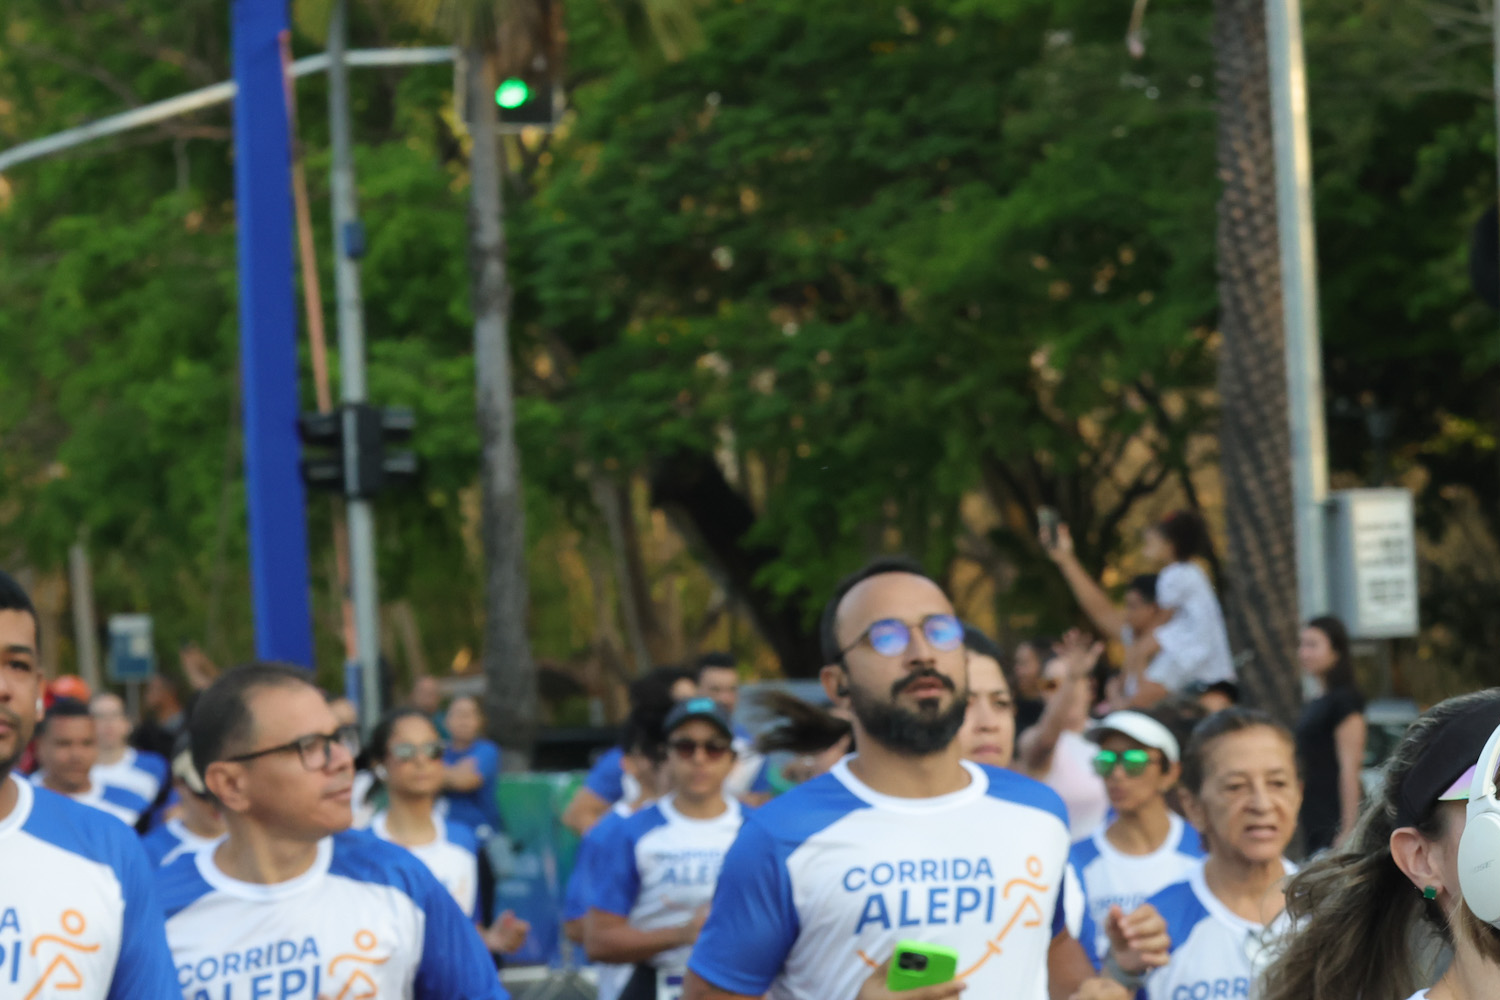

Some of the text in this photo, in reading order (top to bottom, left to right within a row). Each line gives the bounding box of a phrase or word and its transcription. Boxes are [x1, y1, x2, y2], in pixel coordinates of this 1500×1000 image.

[842, 856, 994, 892] CORRIDA
[854, 885, 996, 935] ALEPI
[177, 936, 320, 990] CORRIDA
